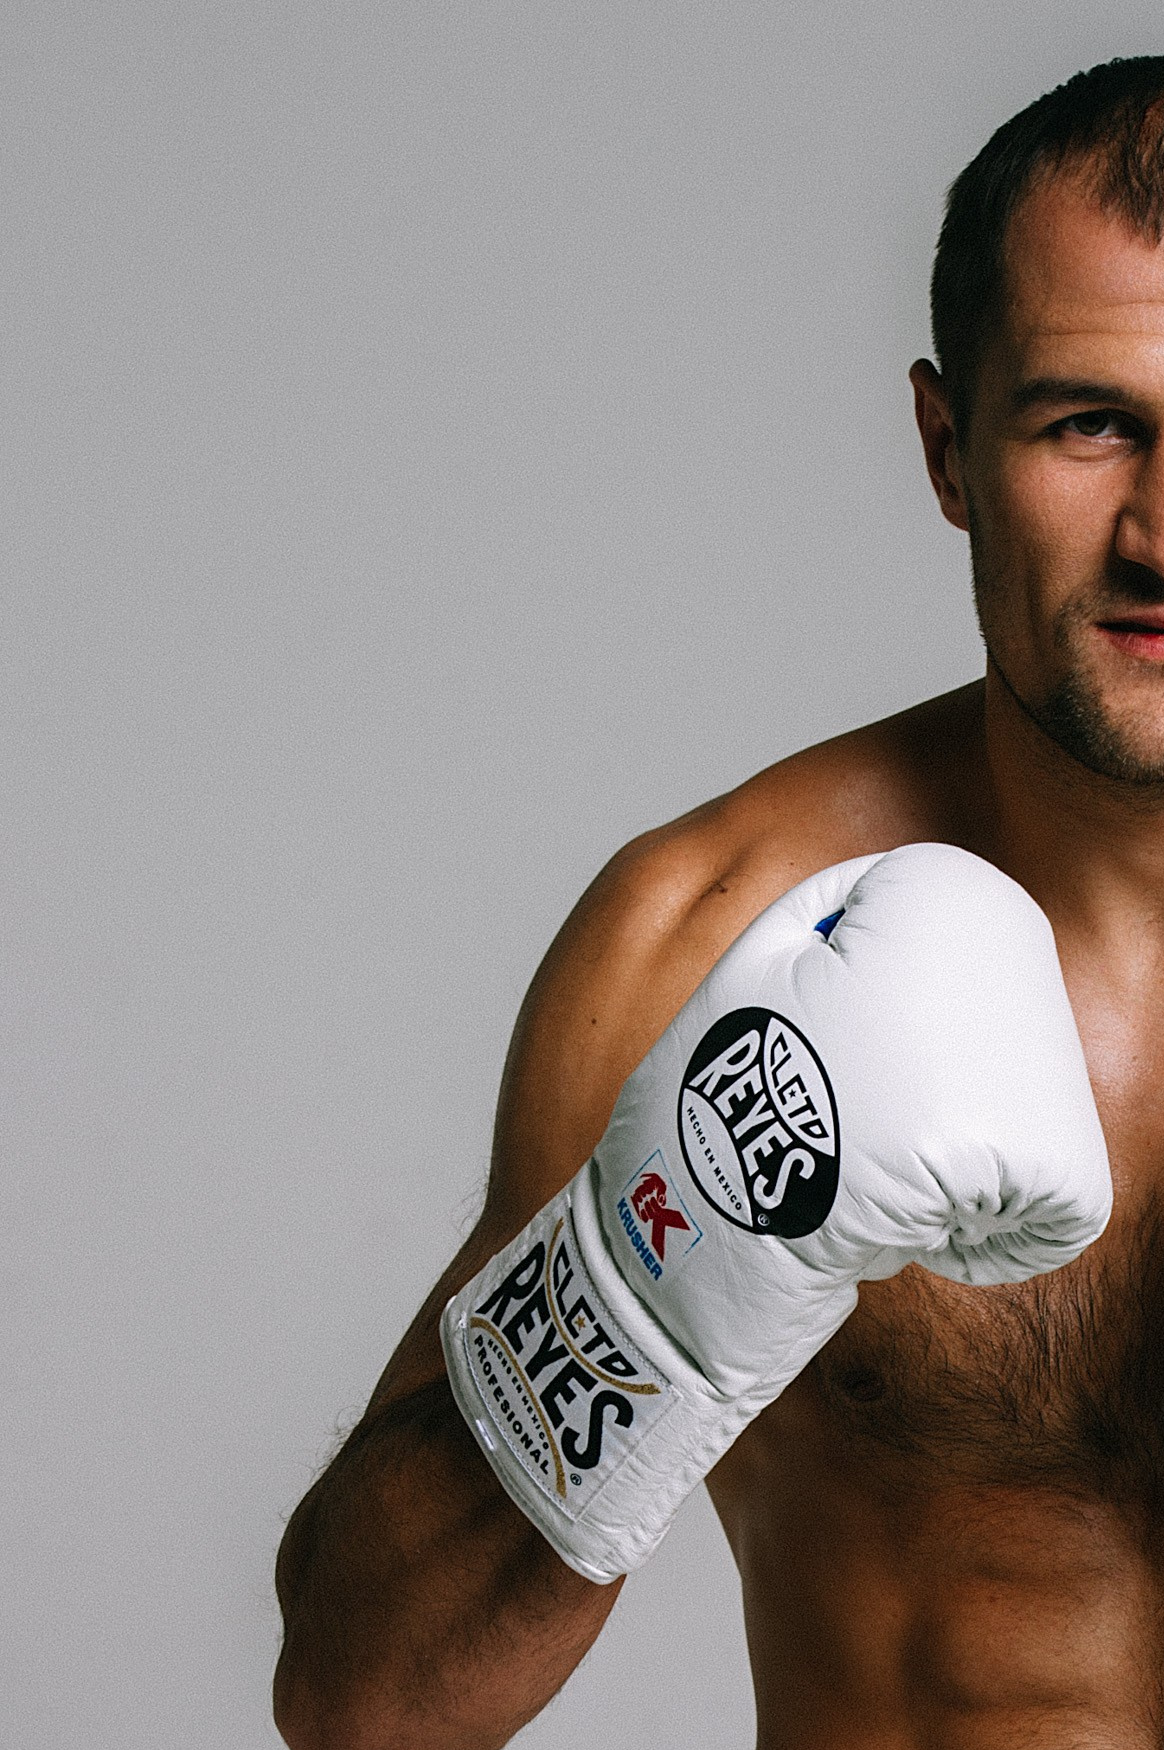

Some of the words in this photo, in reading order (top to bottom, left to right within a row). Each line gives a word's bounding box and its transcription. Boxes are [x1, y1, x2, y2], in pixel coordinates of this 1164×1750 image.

[686, 1106, 706, 1146] HECHO
[704, 1148, 715, 1164] EN
[713, 1167, 742, 1211] MEXICO
[688, 1029, 816, 1210] REYES
[617, 1197, 664, 1281] KRUSHER
[474, 1334, 550, 1475] PROFESIONAL
[475, 1241, 634, 1470] REYES
[487, 1338, 512, 1376] HECHO
[512, 1376, 523, 1394] EN
[521, 1395, 550, 1450] MEXICO
